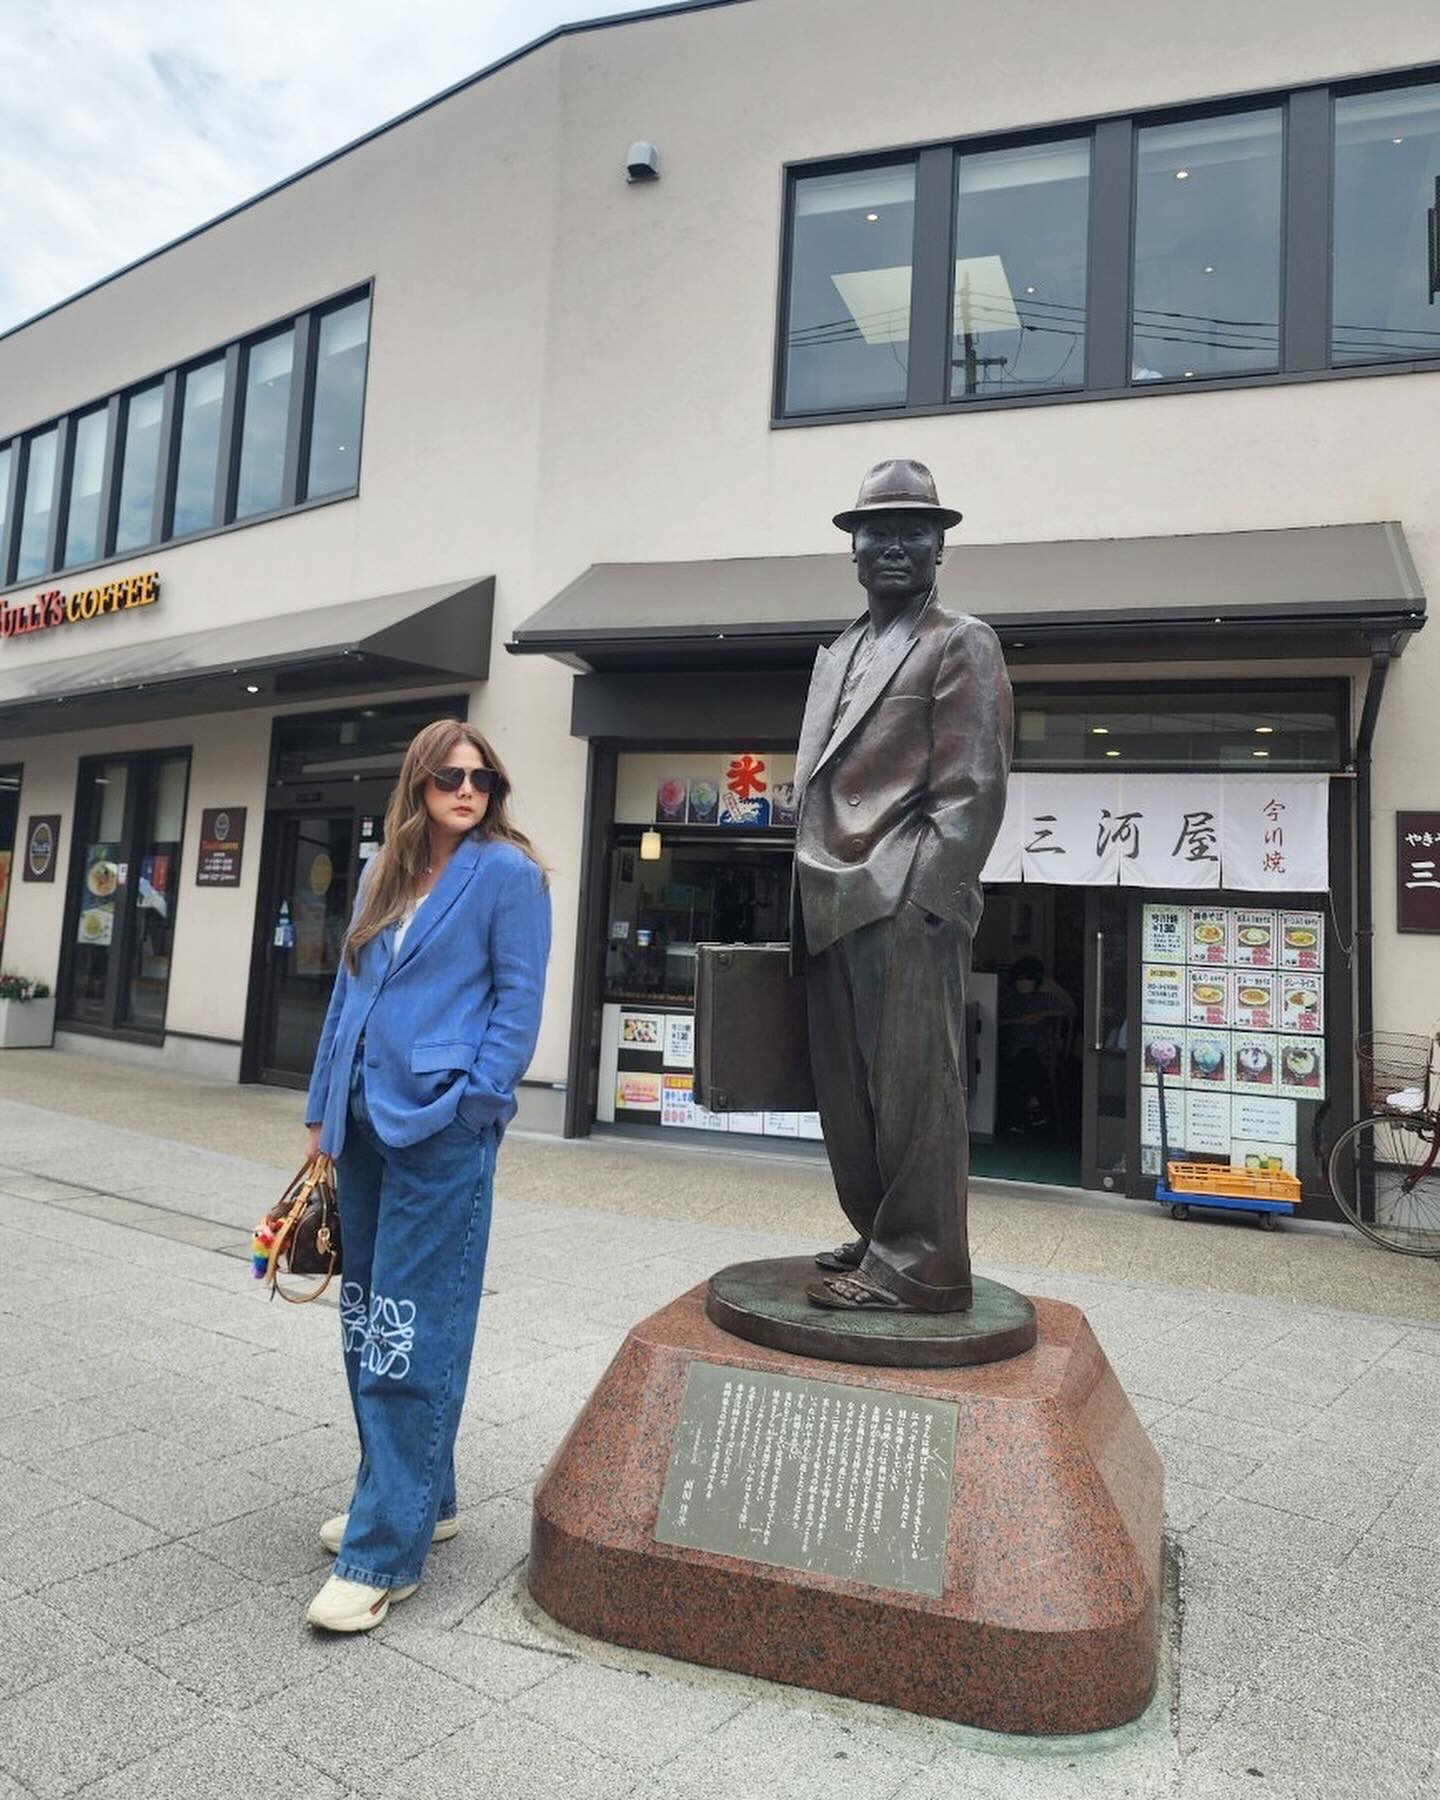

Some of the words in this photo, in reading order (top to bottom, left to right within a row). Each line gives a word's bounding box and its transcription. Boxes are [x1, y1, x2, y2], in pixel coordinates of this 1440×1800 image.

[66, 573, 159, 624] COFFEE
[727, 754, 767, 800] 氷
[1024, 809, 1219, 862] 三河屋
[1263, 798, 1287, 874] 今川焼
